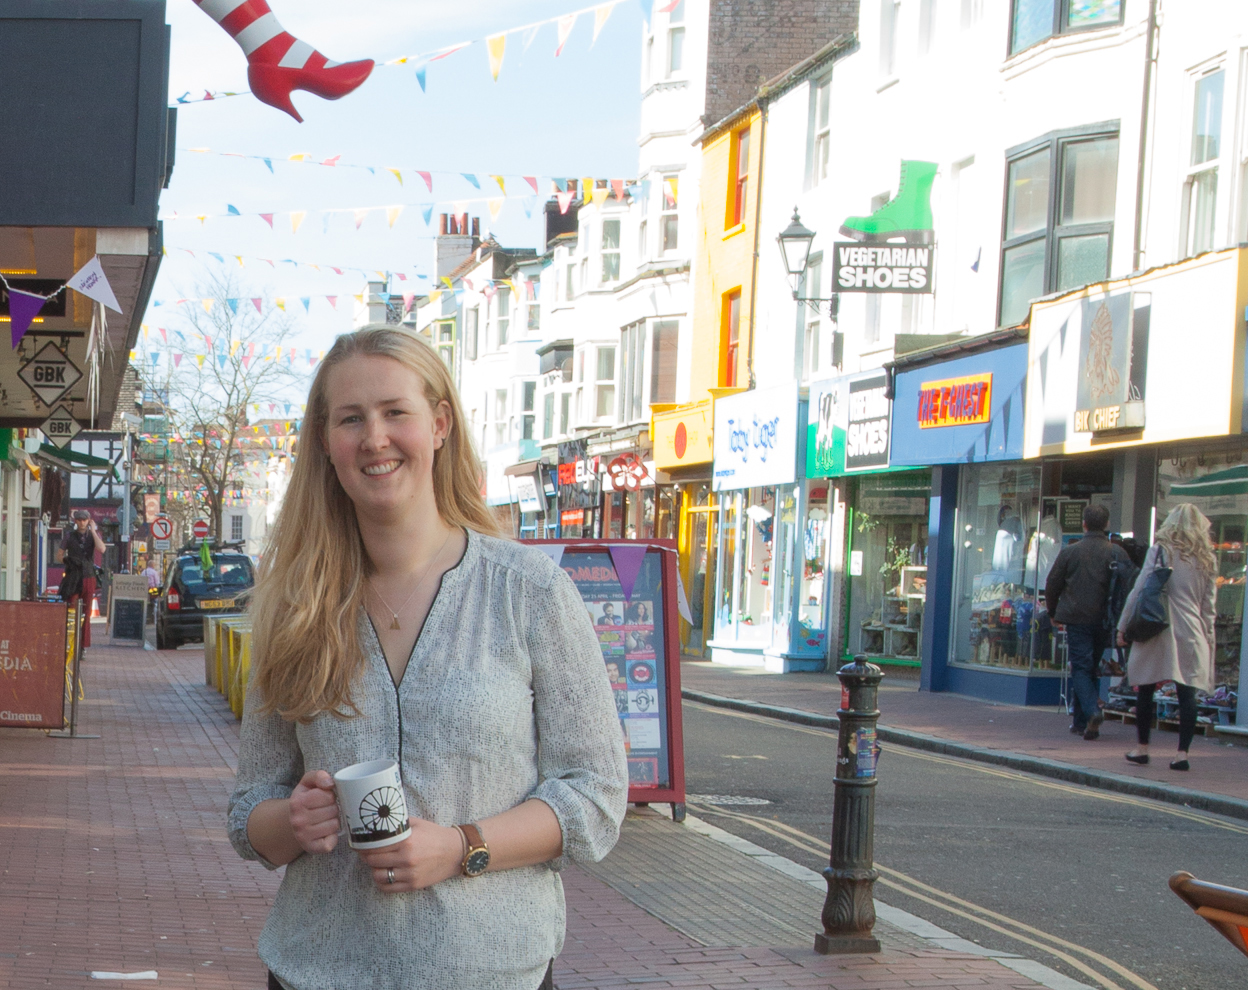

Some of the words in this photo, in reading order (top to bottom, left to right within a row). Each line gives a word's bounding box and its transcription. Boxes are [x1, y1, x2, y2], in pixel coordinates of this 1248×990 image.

[839, 247, 928, 267] VEGETARIAN
[838, 266, 927, 288] SHOES
[34, 366, 65, 382] GBK
[917, 389, 940, 425] THE
[940, 382, 989, 423] T-CHEST
[1094, 406, 1121, 429] CHIEF
[50, 422, 71, 433] GBK
[847, 419, 888, 457] SHOES
[563, 566, 619, 581] OMEDI
[1, 639, 10, 650] AT
[0, 710, 42, 721] Cinema
